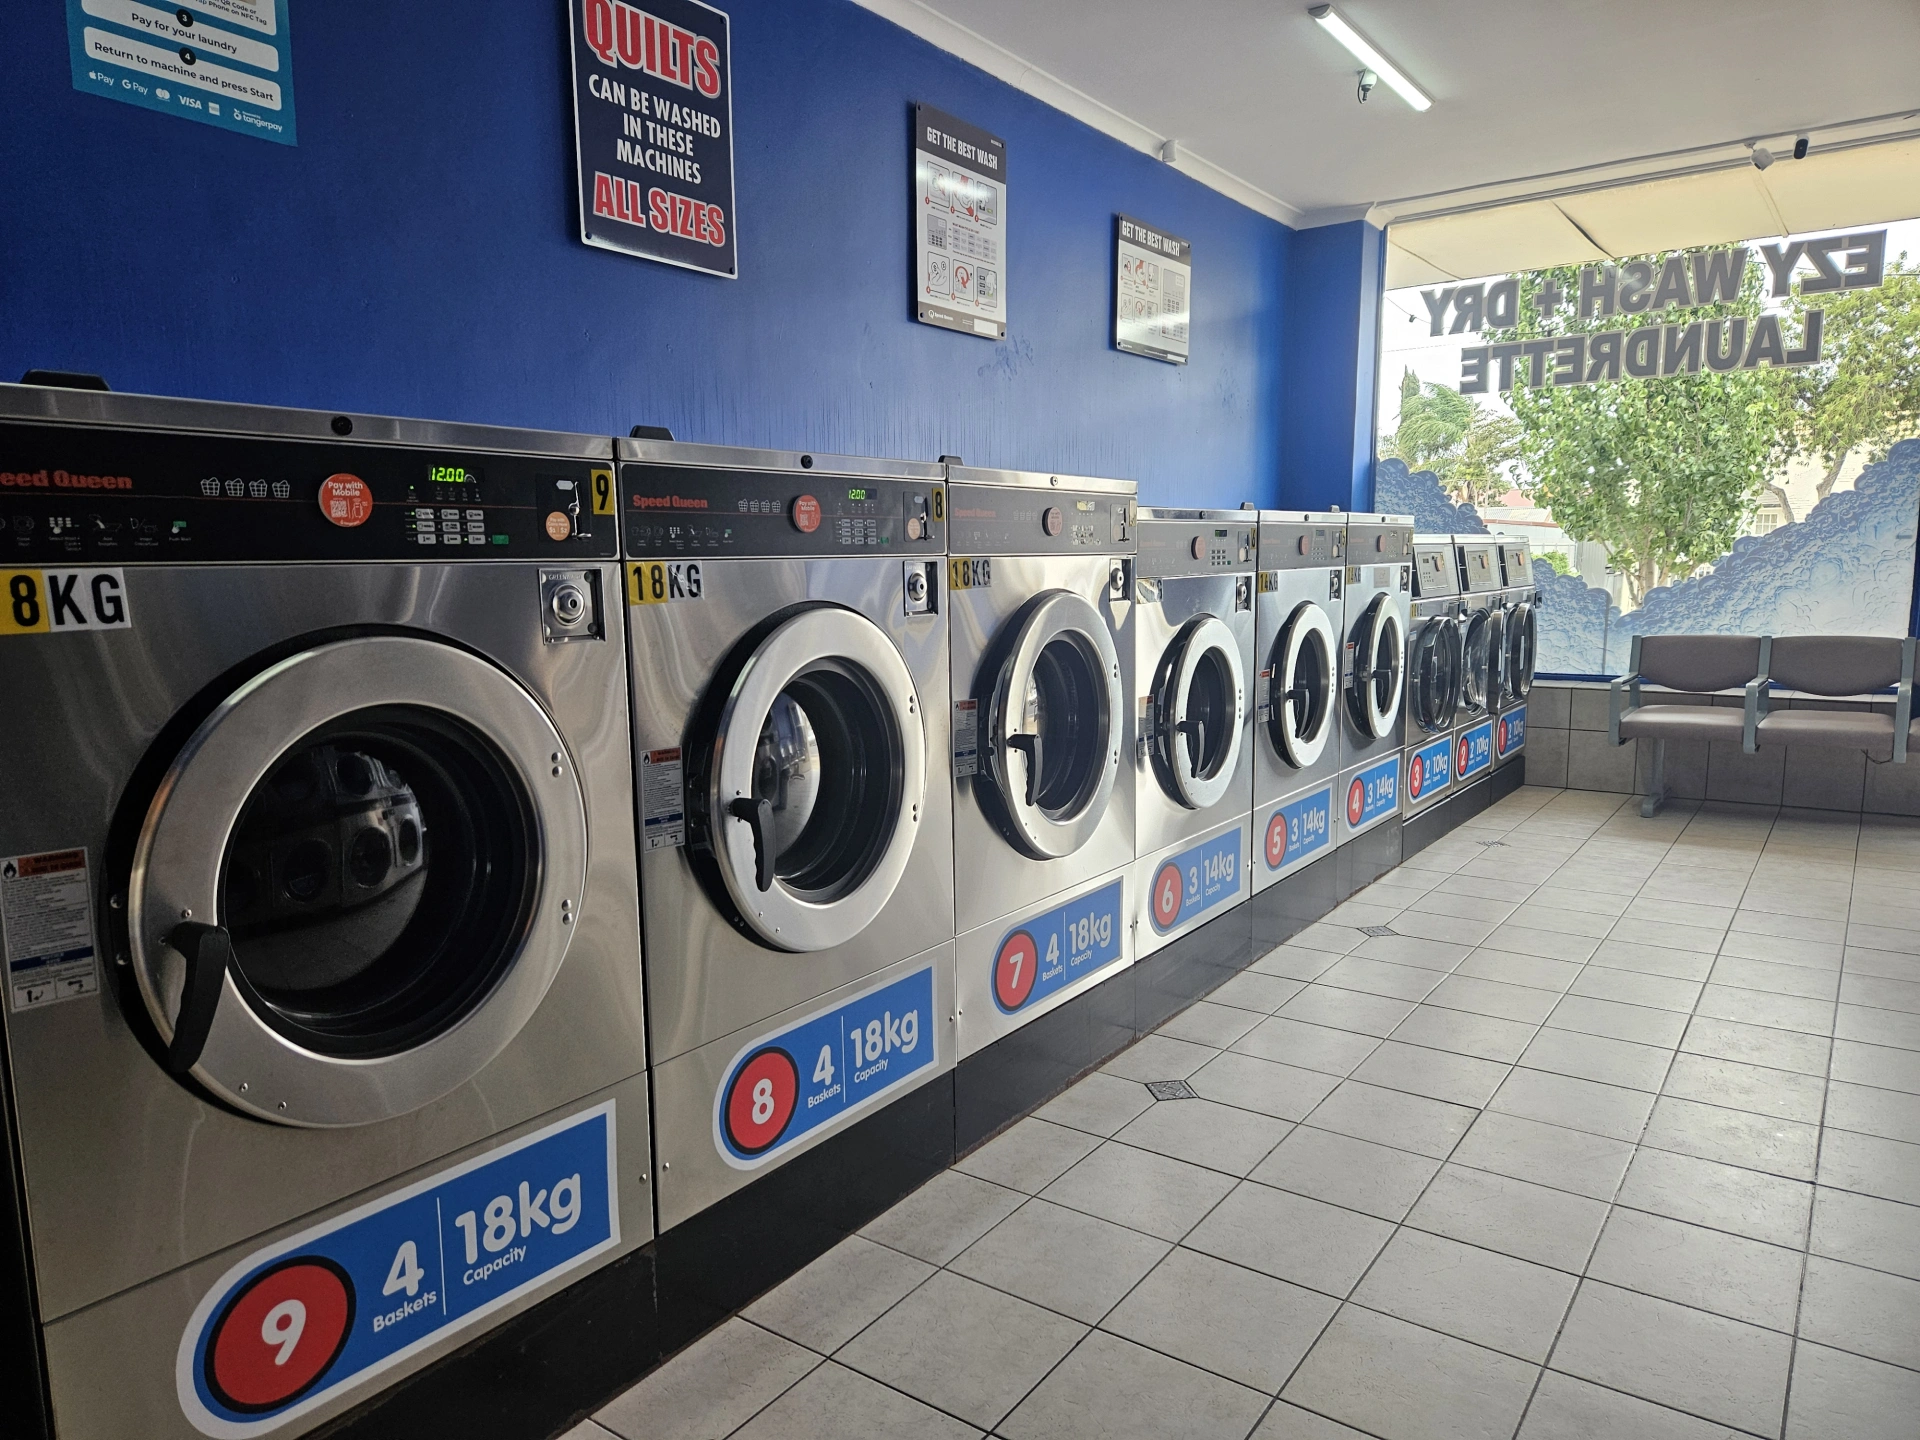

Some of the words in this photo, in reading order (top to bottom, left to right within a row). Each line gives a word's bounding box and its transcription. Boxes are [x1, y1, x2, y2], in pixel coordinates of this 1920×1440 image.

[181, 14, 188, 22] 3
[208, 1, 230, 13] Phone
[240, 11, 255, 21] NFC
[255, 16, 268, 26] Tag
[231, 2, 249, 12] Code
[131, 12, 152, 28] Pay
[154, 20, 170, 32] for
[172, 26, 197, 40] your
[198, 33, 238, 55] laundry
[184, 52, 191, 61] 4
[582, 0, 722, 99] QUILTS
[94, 41, 134, 61] Return
[136, 53, 149, 65] to
[150, 59, 198, 79] machine
[199, 74, 219, 86] and
[221, 80, 249, 94] press
[250, 87, 275, 102] Start
[97, 72, 115, 86] Pay
[132, 82, 149, 96] Pay
[177, 94, 203, 110] VISA
[588, 74, 626, 107] CAN
[630, 87, 650, 115] BE
[652, 95, 721, 139] WASHED
[623, 112, 643, 140] IN
[646, 120, 694, 157] THESE
[926, 126, 942, 146] GET
[942, 133, 957, 153] THE
[957, 139, 977, 161] BEST
[976, 148, 998, 171] WASH
[616, 138, 702, 184] MACHINES
[592, 170, 647, 228] ALL
[648, 186, 726, 248] SIZES
[1121, 220, 1135, 239] GET
[1135, 225, 1147, 244] THE
[1146, 230, 1163, 250] BEST
[1162, 236, 1180, 257] WASH
[52, 470, 134, 490] Queen
[327, 480, 345, 492] Pay
[345, 482, 363, 490] with
[430, 467, 465, 482] 12.00
[332, 489, 361, 497] Mobile
[595, 473, 610, 511] 9
[632, 494, 671, 509] Speed
[671, 495, 708, 509] Queen
[935, 490, 943, 519] 8
[954, 507, 976, 519] Speed
[1460, 745, 1466, 767] 2
[1469, 741, 1475, 759] 2
[1413, 764, 1420, 788] 3
[1425, 759, 1431, 779] 2
[1432, 752, 1449, 775] 10kg
[1352, 788, 1360, 813] 4
[1367, 782, 1374, 804] 3
[1376, 773, 1395, 799] 14kg
[1291, 817, 1299, 842] 3
[1302, 806, 1326, 834] 14kg
[1272, 825, 1281, 855] 5
[1188, 866, 1198, 895] 3
[1203, 850, 1235, 886] 14kg
[1161, 879, 1174, 914] 6
[1185, 893, 1201, 907] Baskets
[1204, 882, 1222, 897] Capacity
[1045, 932, 1060, 966] 4
[1068, 911, 1112, 955] 18kg
[1009, 951, 1024, 989] 7
[1070, 949, 1093, 967] Capacity
[1042, 964, 1064, 982] Baskets
[812, 1044, 835, 1086] 4
[850, 1009, 919, 1069] 18kg
[853, 1057, 889, 1084] Capacity
[751, 1078, 775, 1125] 8
[807, 1083, 841, 1109] Baskets
[381, 1240, 424, 1297] 4
[454, 1172, 582, 1265] 18kg
[462, 1244, 527, 1286] Capacity
[372, 1289, 438, 1333] Baskets
[261, 1298, 307, 1366] 9
